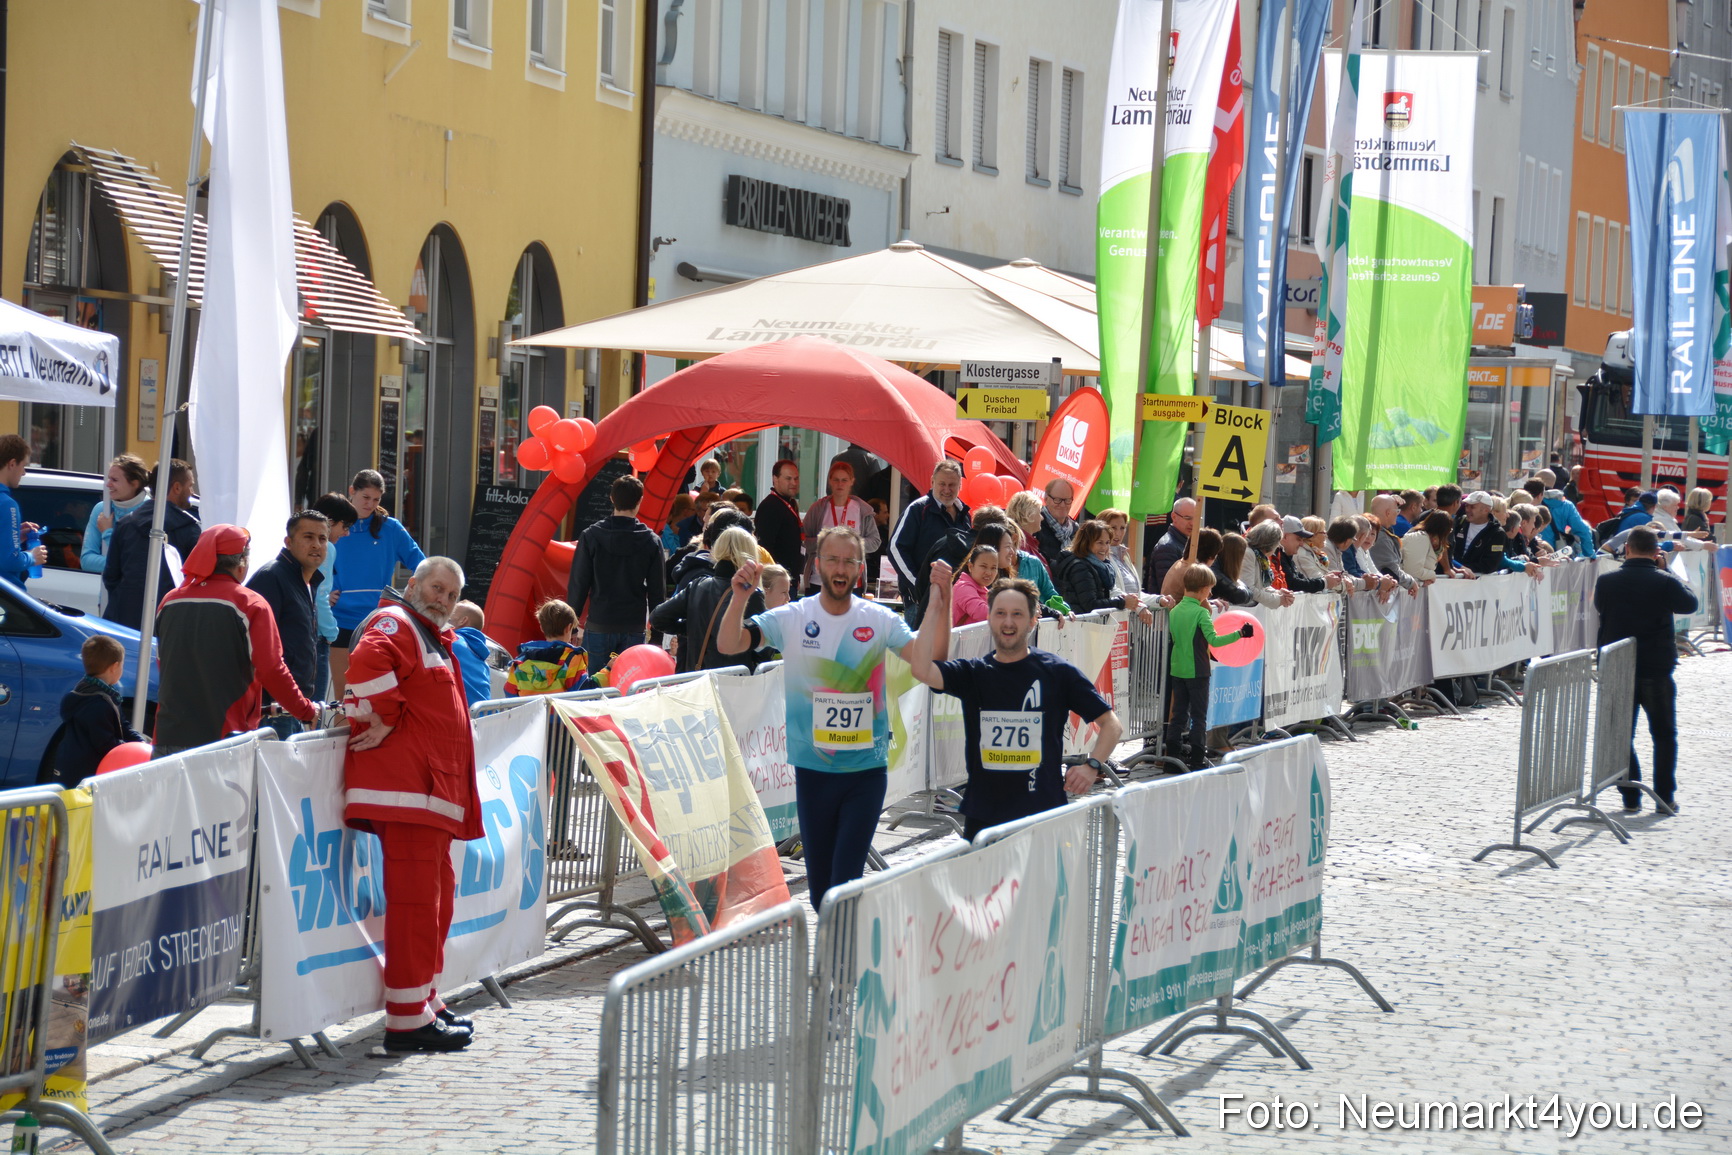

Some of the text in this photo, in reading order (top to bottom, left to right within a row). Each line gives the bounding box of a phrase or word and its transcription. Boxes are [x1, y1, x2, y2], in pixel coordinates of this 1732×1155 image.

[737, 174, 851, 247] BRILLEN WEBER
[1670, 213, 1695, 394] RAIL.ONE
[752, 318, 921, 335] Neumarkter
[966, 363, 1040, 381] Klostergasse
[983, 394, 1020, 403] Duschen
[986, 405, 1017, 414] Freibad
[1152, 409, 1186, 419] ausgabe
[1215, 408, 1263, 430] Block
[1059, 445, 1081, 464] DKMS
[1212, 434, 1249, 482] A
[485, 487, 529, 505] fritz-kola
[837, 697, 865, 705] Neumarkt
[826, 707, 864, 728] 297
[828, 733, 859, 743] Manuel
[991, 726, 1030, 747] 276
[988, 752, 1031, 763] Stolpmann
[137, 821, 231, 882] RAIL.ONE
[89, 952, 118, 992] AUF
[117, 939, 155, 988] JEDER
[159, 921, 220, 970] STRECKE
